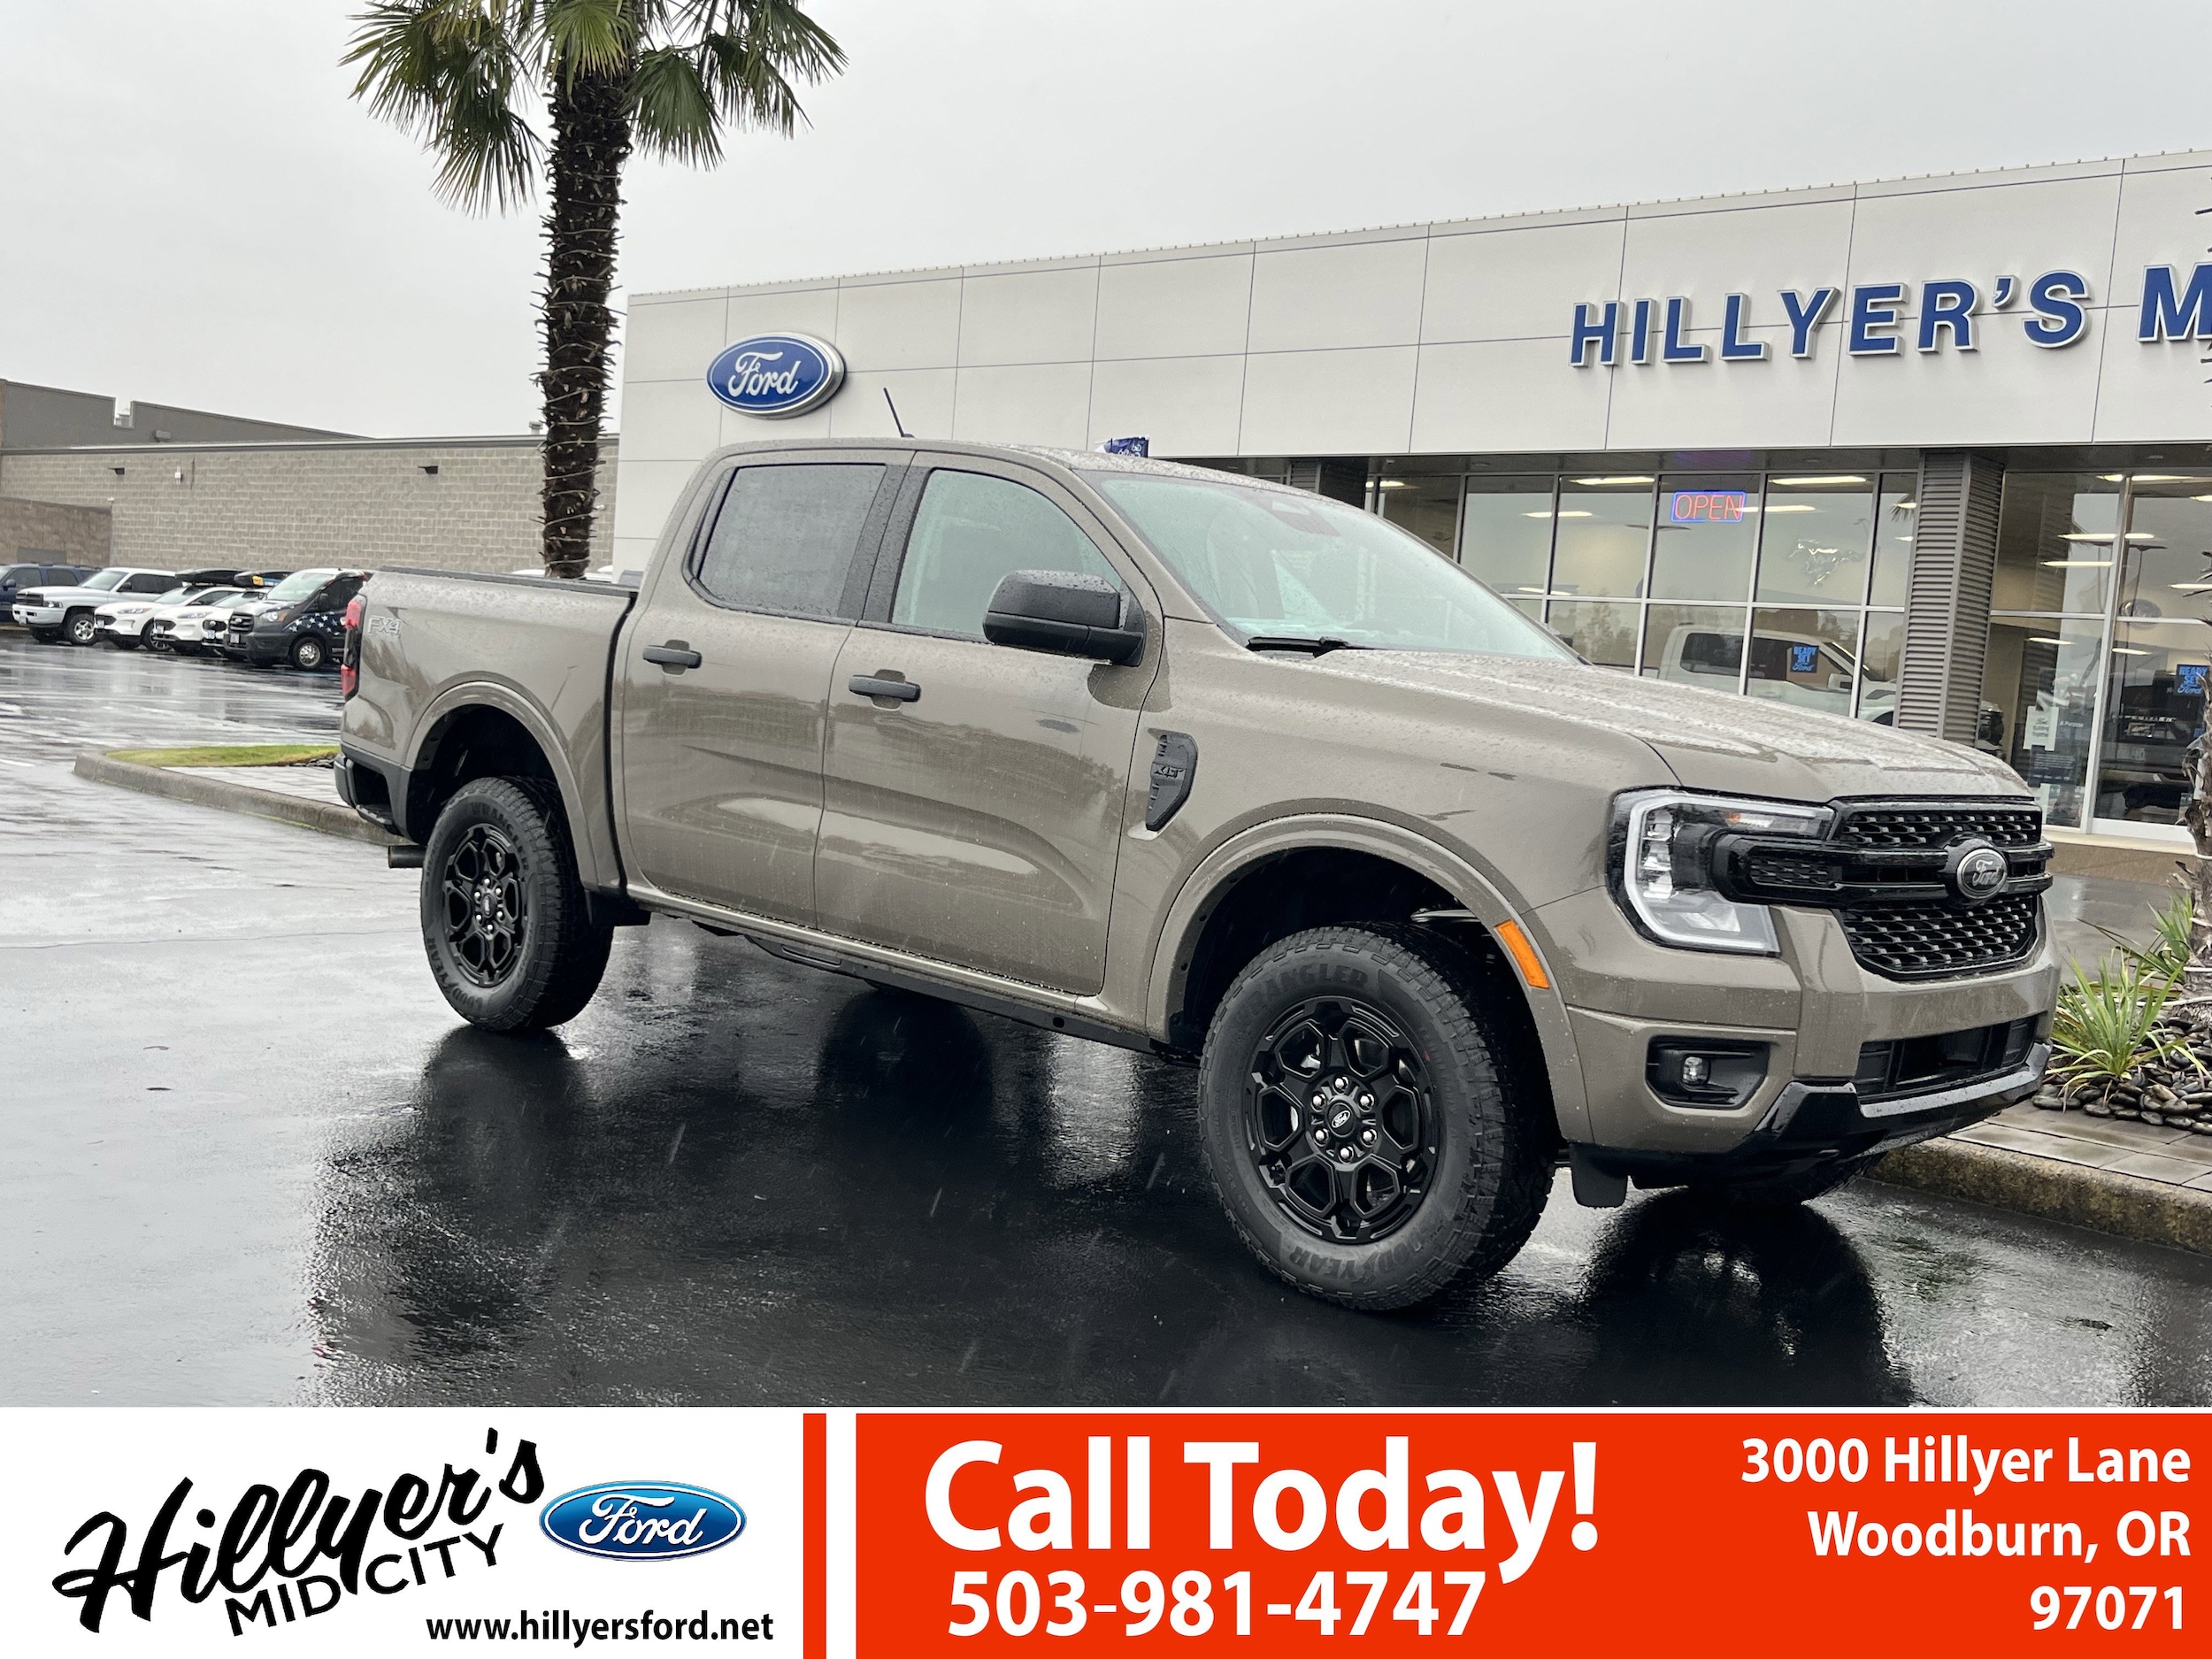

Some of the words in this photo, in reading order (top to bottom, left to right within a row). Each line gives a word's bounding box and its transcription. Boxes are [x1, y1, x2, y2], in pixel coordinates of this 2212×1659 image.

[1570, 268, 2089, 365] HILLYER'S
[728, 351, 801, 397] Ford
[1675, 495, 1742, 519] OPEN
[367, 615, 402, 635] FX4
[1972, 859, 2005, 887] Ford
